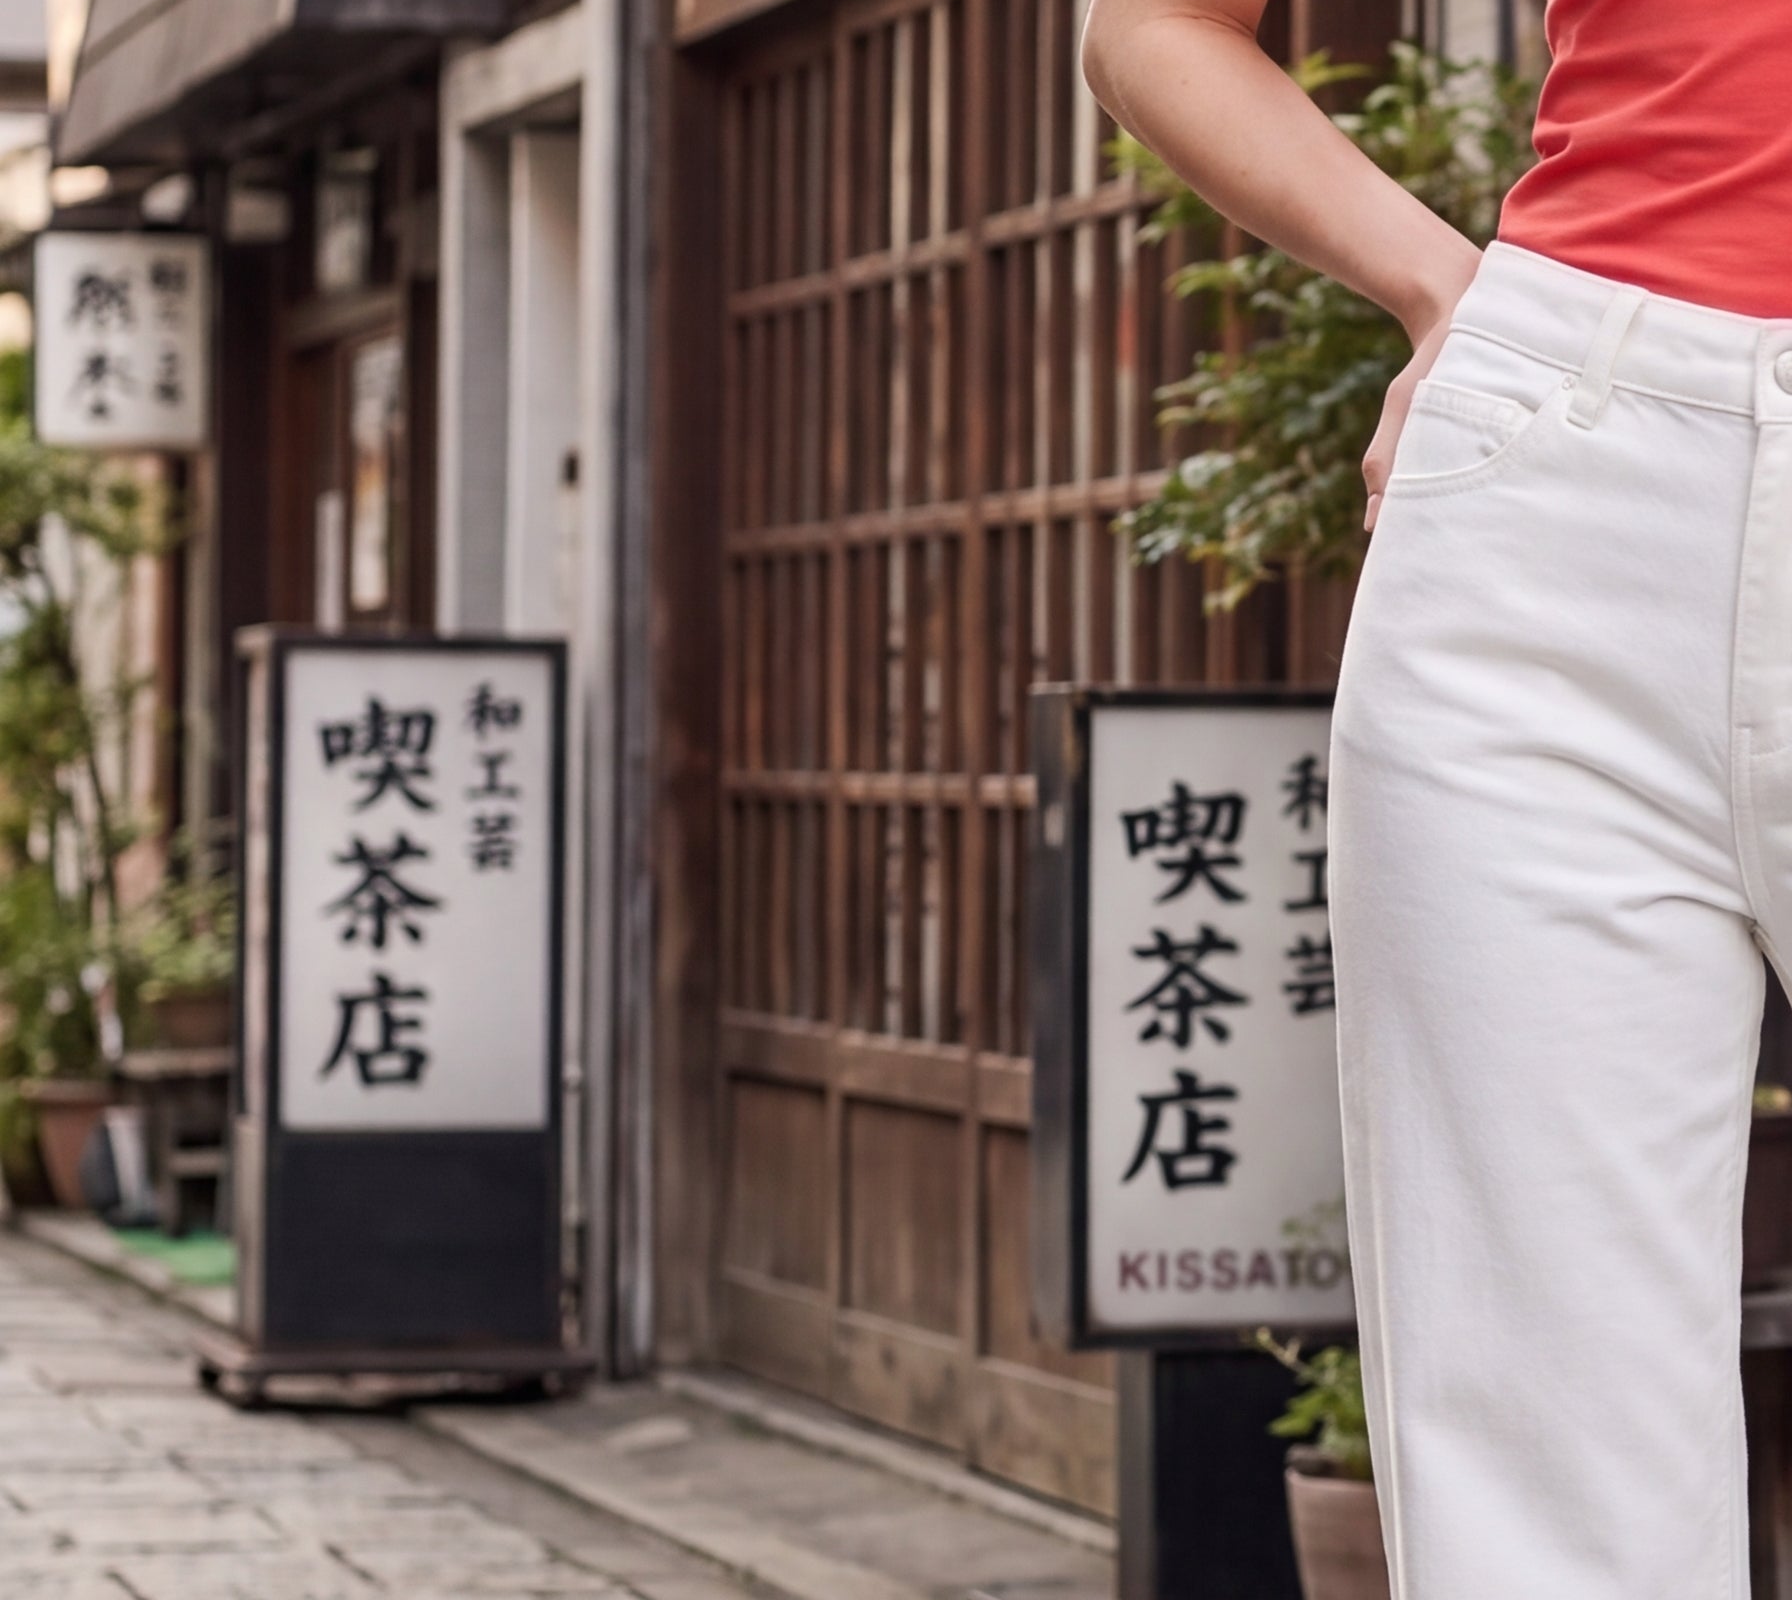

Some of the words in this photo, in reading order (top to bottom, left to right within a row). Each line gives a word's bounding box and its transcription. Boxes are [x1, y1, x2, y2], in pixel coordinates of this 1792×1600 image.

[317, 696, 443, 1091] 喫茶店
[1118, 780, 1250, 1193] 喫茶店
